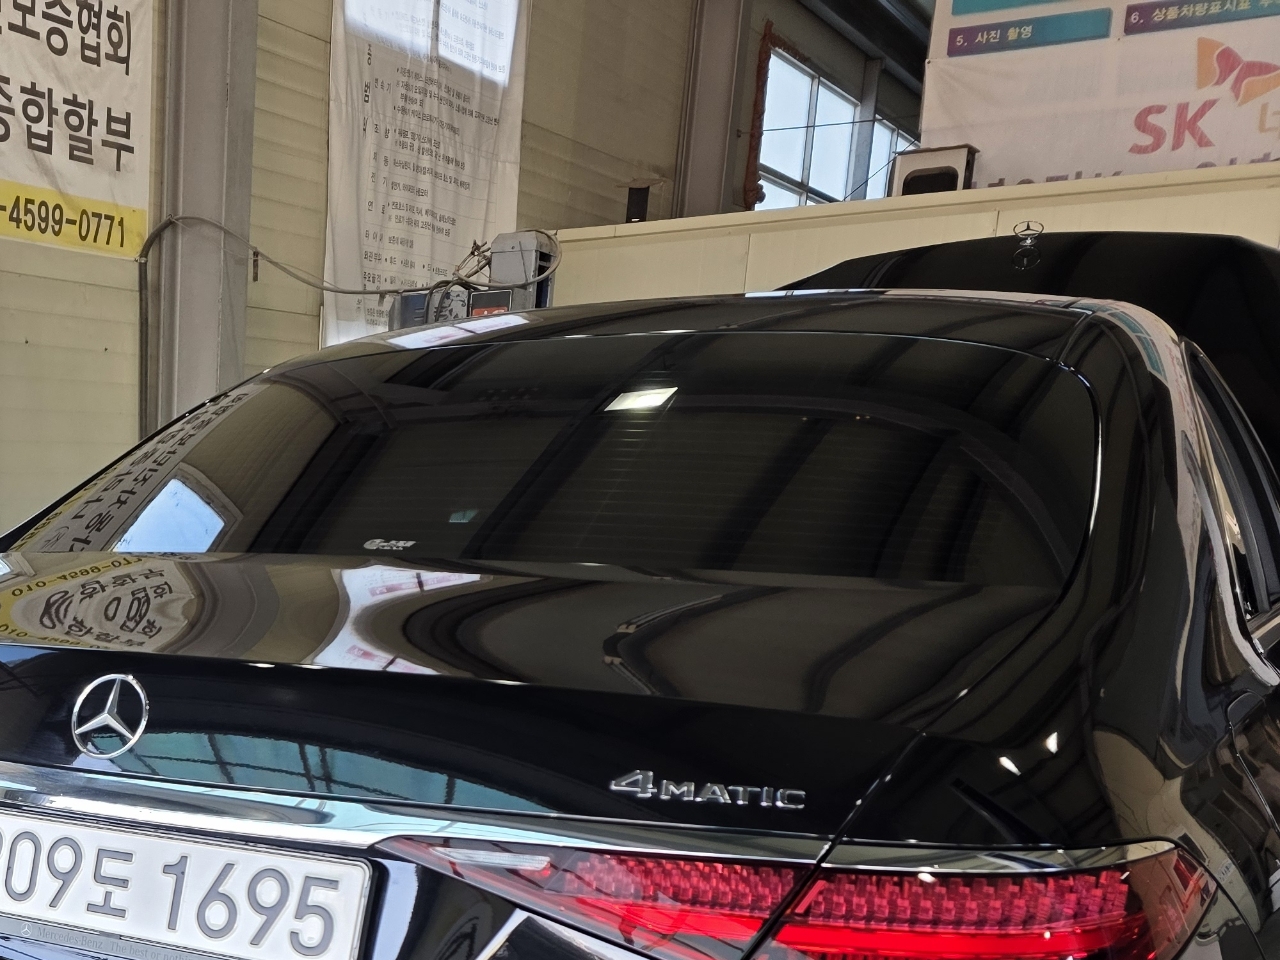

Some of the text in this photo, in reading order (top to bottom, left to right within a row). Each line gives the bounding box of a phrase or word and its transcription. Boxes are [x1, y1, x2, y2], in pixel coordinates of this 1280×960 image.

[956, 25, 1033, 46] 5. 사진 촬영
[1130, 12, 1144, 24] 6.
[1128, 98, 1221, 155] SK
[609, 769, 806, 809] 4MATIC
[162, 854, 340, 957] 1695
[37, 926, 104, 950] Mercedes-Benz
[110, 941, 125, 953] The
[128, 944, 148, 960] best
[151, 951, 161, 960] or
